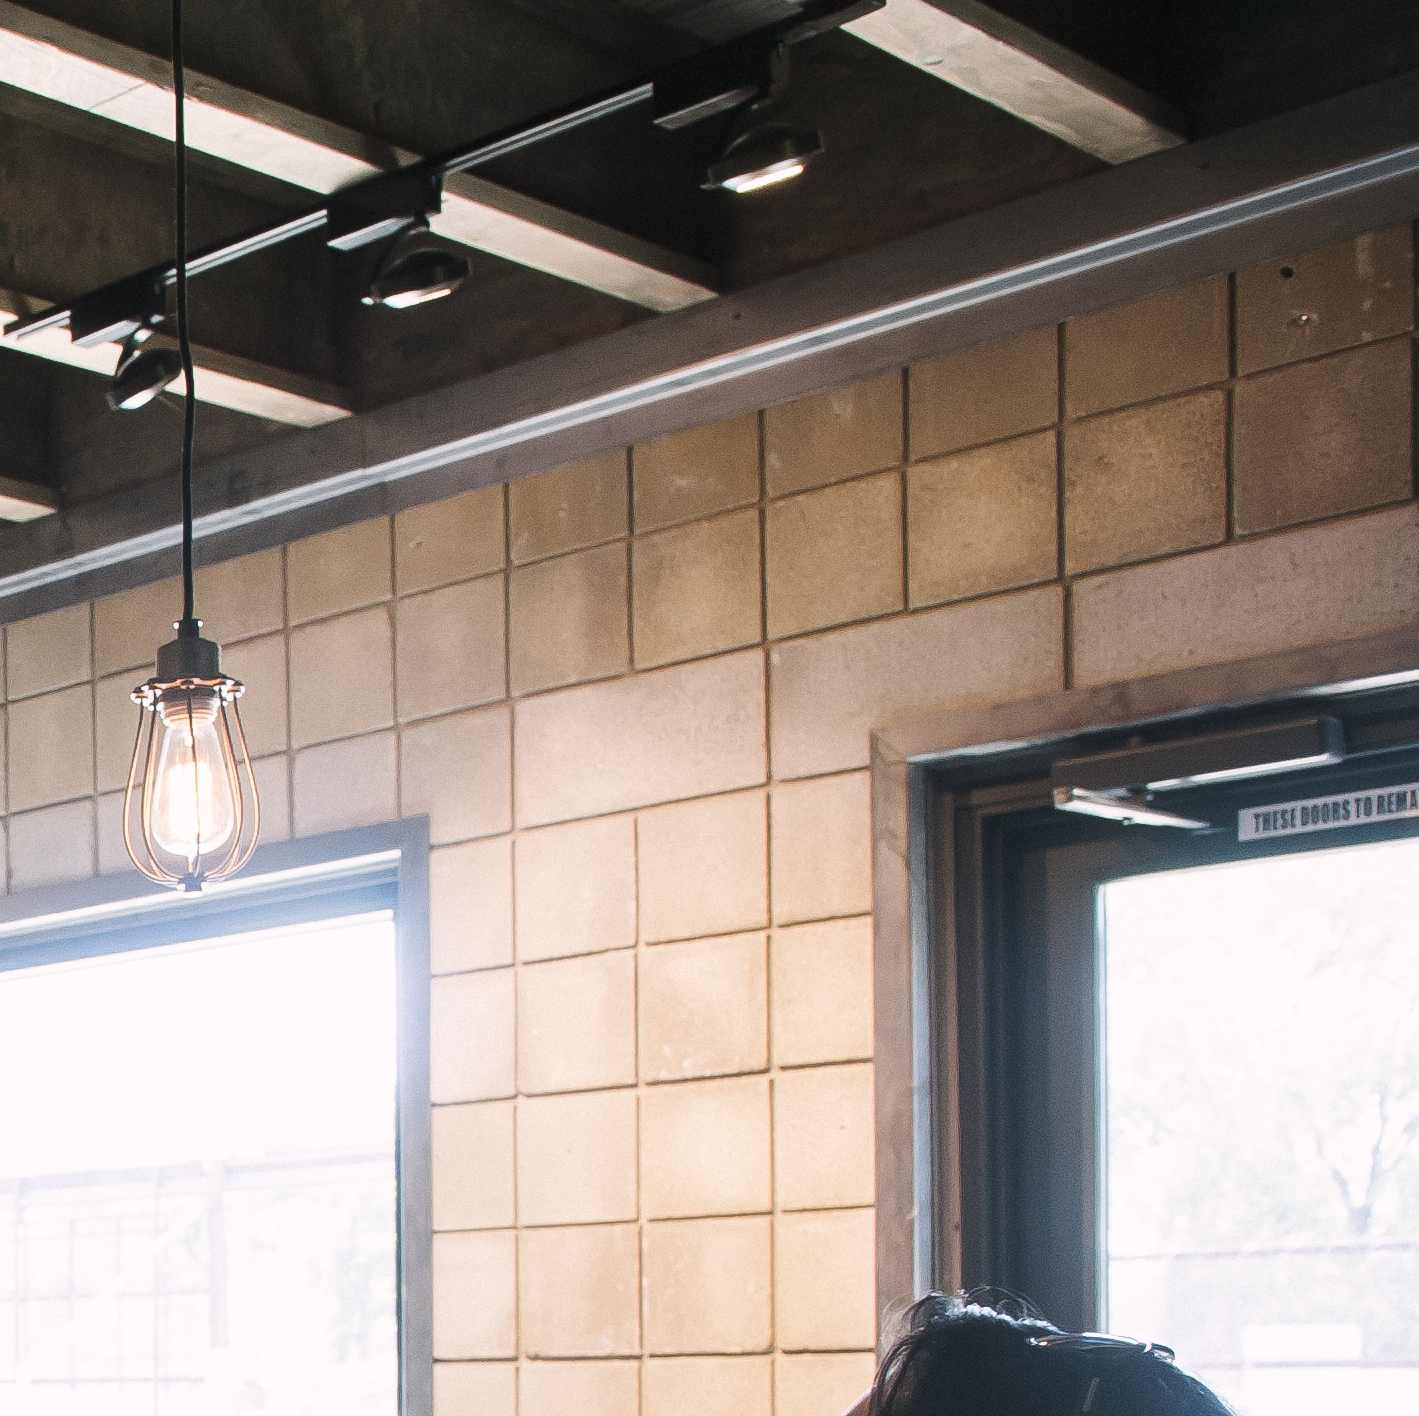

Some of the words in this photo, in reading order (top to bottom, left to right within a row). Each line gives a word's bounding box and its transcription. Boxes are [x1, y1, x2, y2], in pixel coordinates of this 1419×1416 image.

[1253, 808, 1297, 833] THESE
[1300, 799, 1352, 827] DOORS
[1354, 797, 1373, 818] TO
